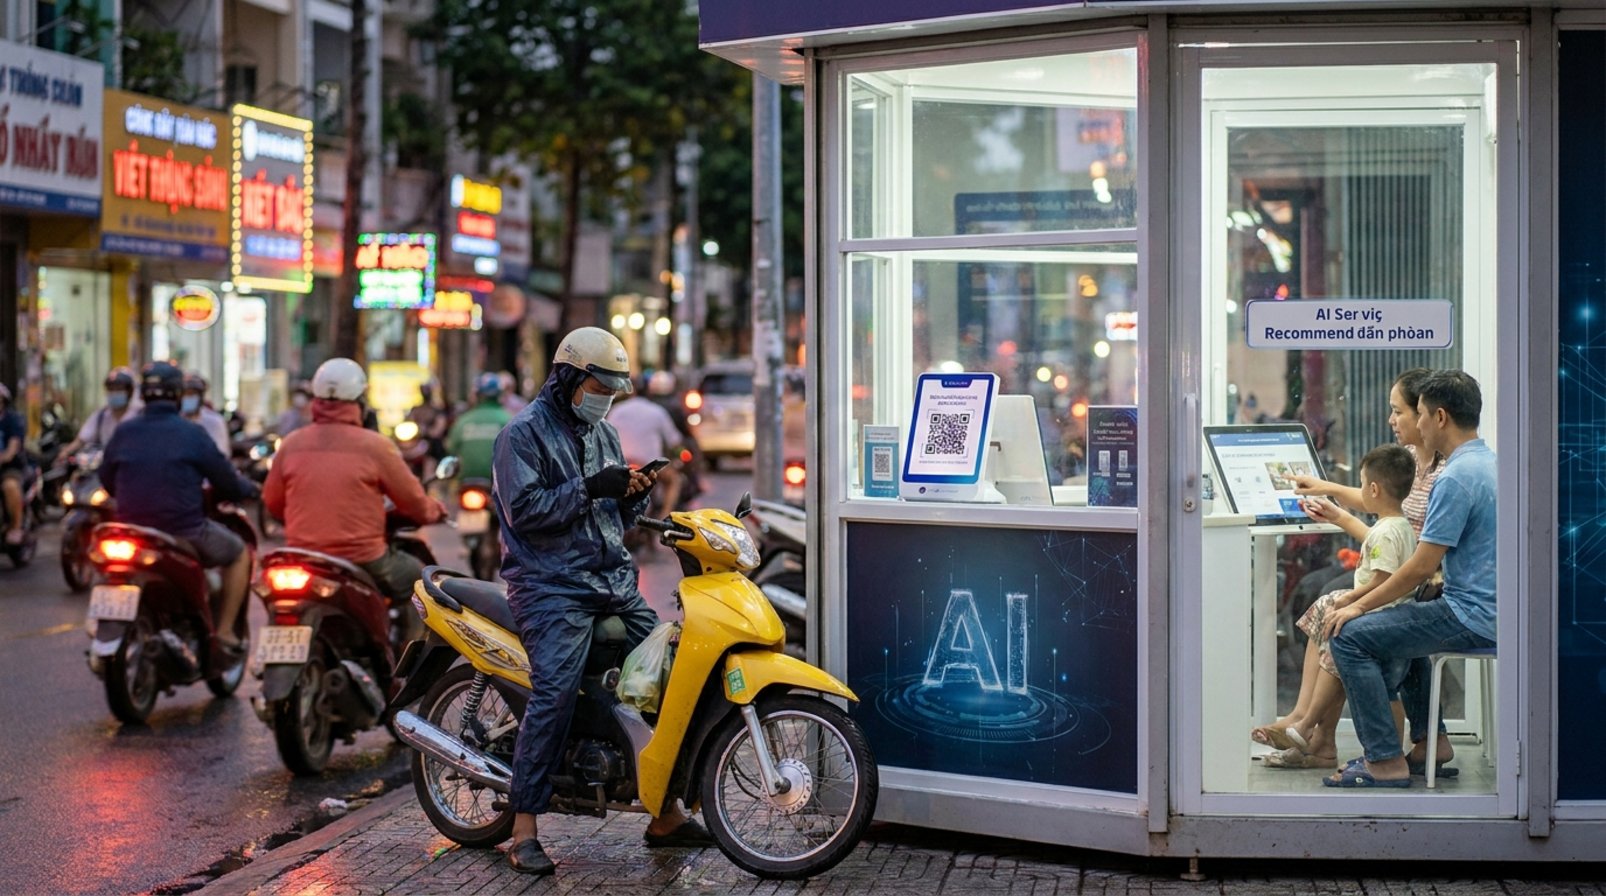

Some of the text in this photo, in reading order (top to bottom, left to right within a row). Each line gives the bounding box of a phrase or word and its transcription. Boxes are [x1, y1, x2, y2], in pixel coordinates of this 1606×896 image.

[1316, 308, 1331, 321] AI
[1334, 308, 1359, 321] Ser
[1264, 326, 1354, 340] Recommend
[1388, 326, 1434, 342] phòan
[922, 588, 1029, 695] AI
